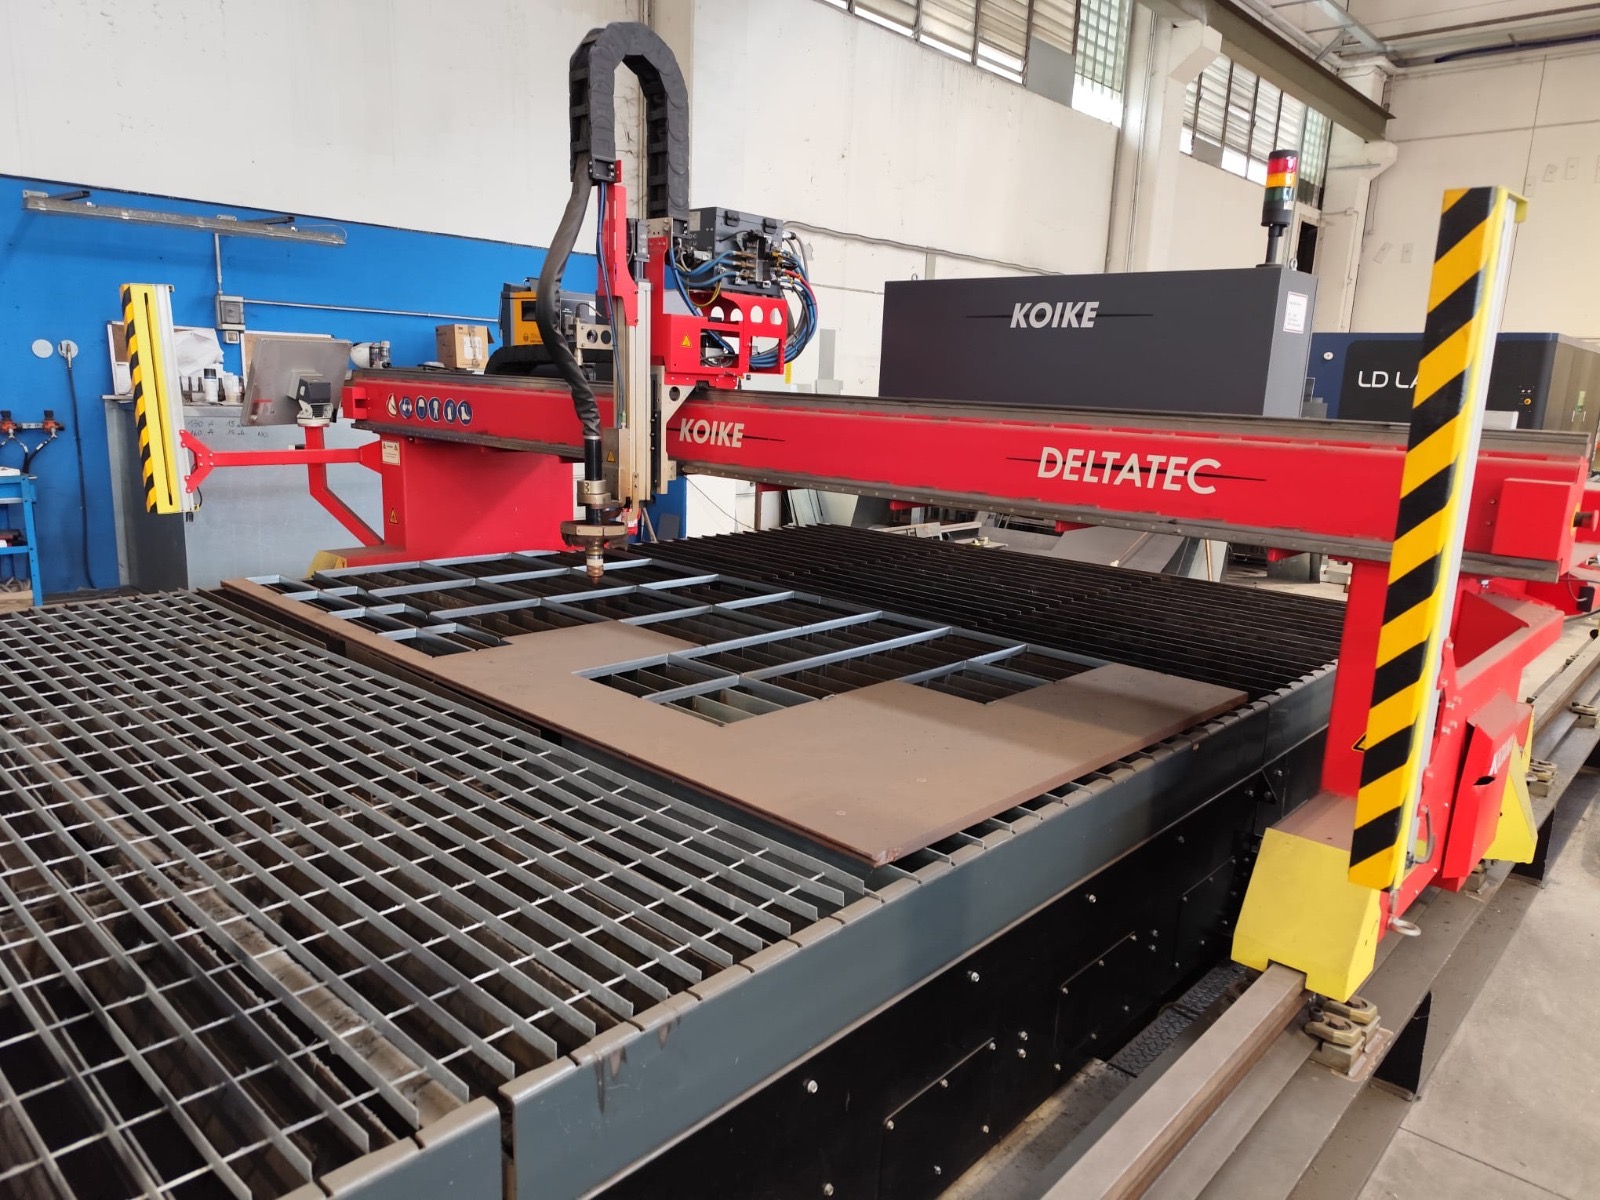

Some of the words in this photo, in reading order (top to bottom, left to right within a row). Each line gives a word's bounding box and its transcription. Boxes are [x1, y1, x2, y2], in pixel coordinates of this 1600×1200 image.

[1010, 301, 1100, 328] KOIKE
[1358, 370, 1389, 388] LD
[1395, 371, 1419, 389] LA
[679, 418, 745, 448] KOIKE
[1037, 446, 1222, 495] DELTATEC
